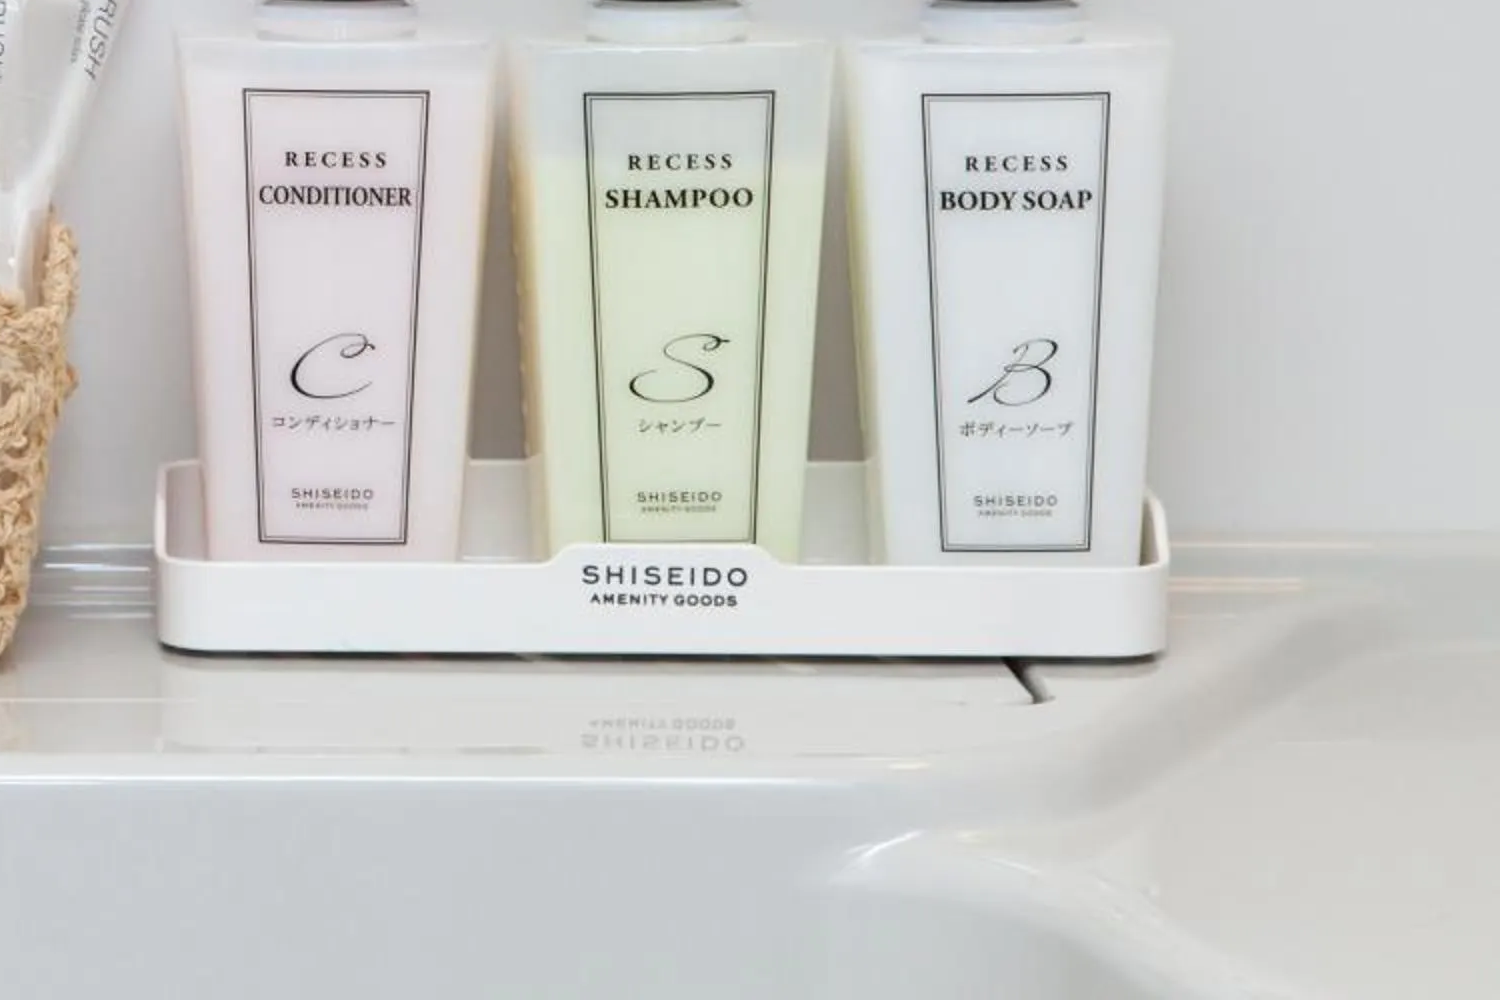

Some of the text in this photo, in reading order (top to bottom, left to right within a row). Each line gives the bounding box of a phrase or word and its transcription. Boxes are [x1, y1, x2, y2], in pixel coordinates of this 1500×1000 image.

[284, 151, 387, 168] RECESS
[627, 154, 733, 171] RECESS
[965, 155, 1068, 172] RECESS
[259, 185, 412, 207] CONDITIONER
[605, 188, 754, 209] SHAMPOO
[940, 189, 1093, 210] BODY SOAP
[290, 332, 376, 400] C
[629, 333, 731, 403] S
[967, 338, 1059, 407] B
[272, 415, 396, 430] コンディショナー
[638, 416, 722, 434] シャンプー
[959, 420, 1074, 437] ボディーソープ
[291, 487, 375, 500] SHISEIDO
[637, 491, 723, 503] SHISEIDO
[973, 494, 1059, 507] SHISEIDO
[582, 565, 748, 587] SHISEIDO
[590, 593, 738, 607] AMENITY GOODS
